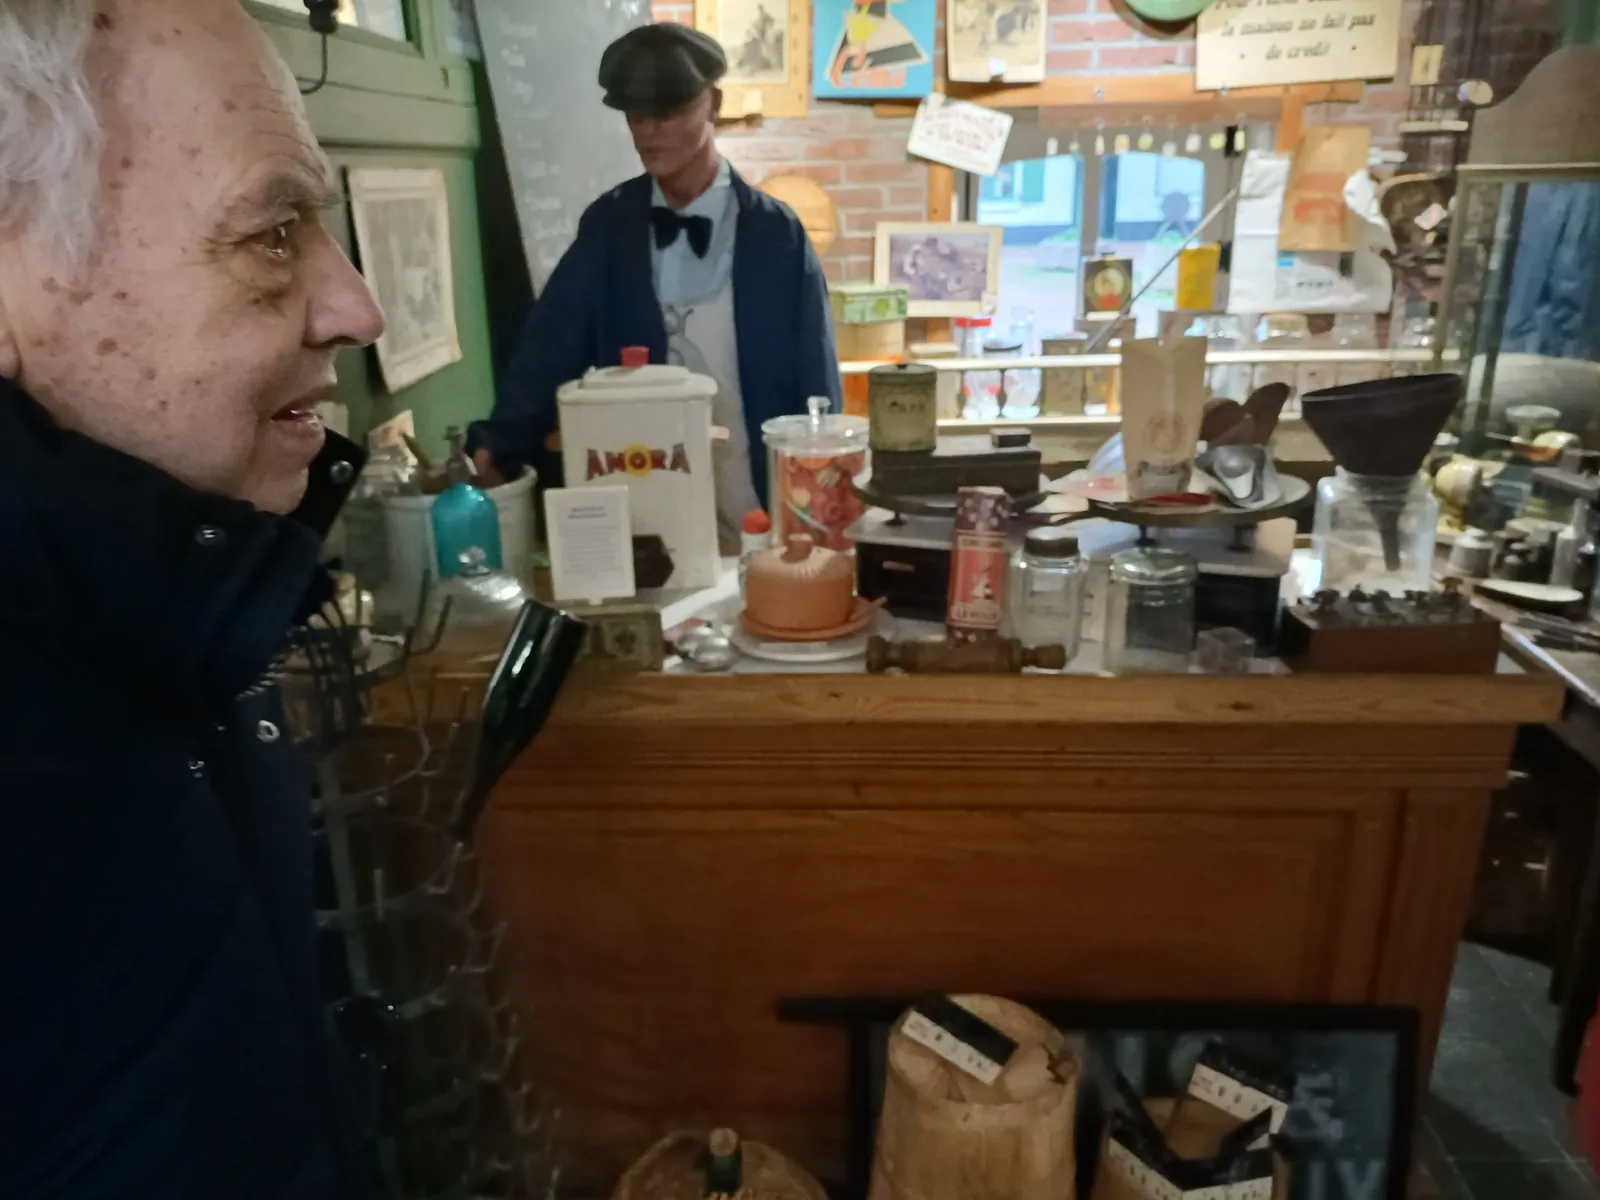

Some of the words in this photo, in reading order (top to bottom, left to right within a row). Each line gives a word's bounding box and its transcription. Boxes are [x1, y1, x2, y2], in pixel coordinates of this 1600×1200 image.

[1346, 14, 1377, 31] pas
[1265, 43, 1282, 60] de
[584, 442, 692, 481] AMORA
